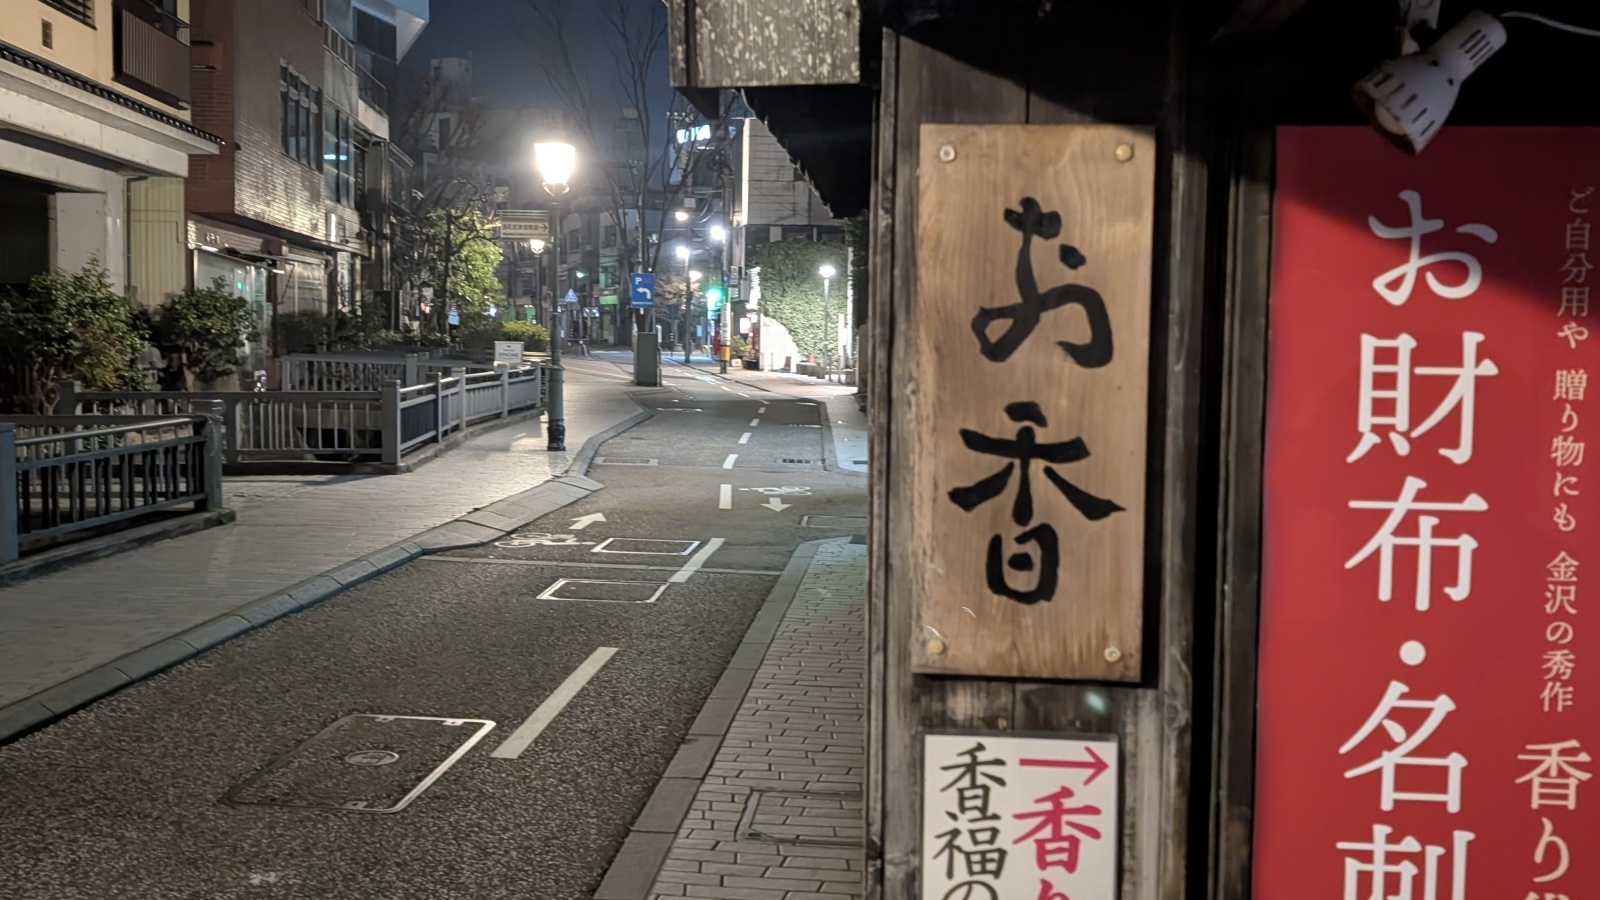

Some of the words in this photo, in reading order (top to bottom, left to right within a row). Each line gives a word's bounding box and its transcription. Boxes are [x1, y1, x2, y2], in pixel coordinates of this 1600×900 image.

[635, 277, 643, 285] P
[1557, 186, 1594, 349] ご自分用や
[948, 197, 1126, 605] お香
[1551, 369, 1588, 531] 贈り物にも
[1540, 551, 1580, 713] 金沢の秀作
[1514, 739, 1593, 900] 香り
